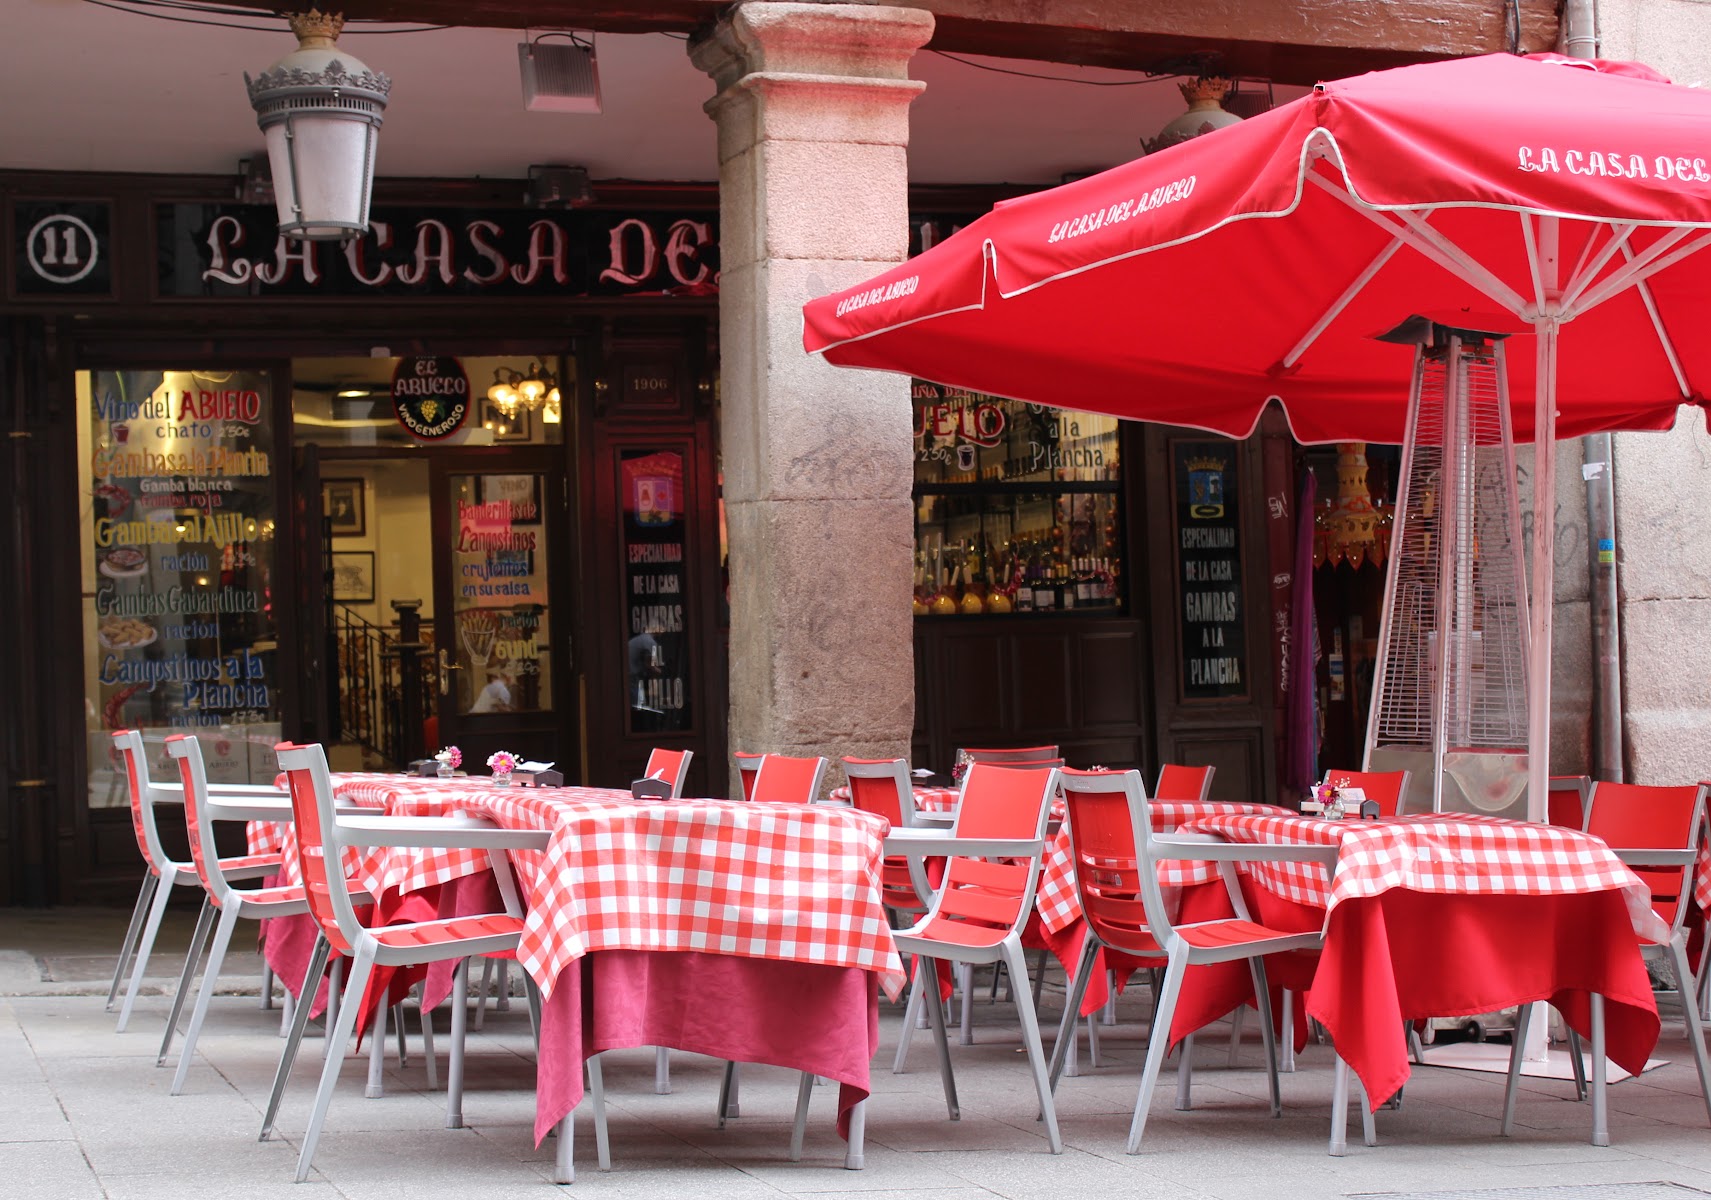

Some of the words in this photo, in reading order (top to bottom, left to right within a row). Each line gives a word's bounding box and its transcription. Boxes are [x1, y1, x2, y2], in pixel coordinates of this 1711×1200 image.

[1518, 146, 1560, 173] LA
[1565, 150, 1648, 179] CASA
[1654, 156, 1711, 182] DEL
[1048, 221, 1069, 243] LA
[1067, 208, 1105, 238] CASA
[1103, 199, 1134, 226] DEL
[1132, 175, 1197, 217] ABUELO
[42, 226, 79, 265] 11
[202, 215, 319, 285] LA
[344, 217, 568, 285] CASA
[598, 218, 720, 286] DE
[415, 360, 438, 375] EL
[394, 377, 466, 396] ABUELO
[633, 377, 669, 391] 1906
[95, 392, 140, 420] Vino
[144, 391, 170, 420] del
[177, 389, 261, 425] ABUELO
[398, 403, 416, 429] VINO
[414, 403, 465, 436] GENEROSO
[156, 422, 212, 438] chato
[92, 446, 177, 478] Gambas
[178, 454, 190, 474] a
[190, 447, 206, 475] la
[207, 446, 270, 477] Plancha
[1028, 440, 1105, 472] Plancha
[139, 478, 185, 492] Gamba
[187, 477, 233, 492] blanca
[189, 491, 223, 516] roja
[457, 498, 520, 520] Banderillas
[521, 500, 536, 520] de
[95, 514, 180, 548] Gambas
[182, 514, 200, 544] al
[203, 512, 258, 549] Ajillo
[456, 525, 537, 558] Langostinos
[1182, 527, 1235, 549] ESPECIALIDAD
[161, 552, 209, 572] ración
[628, 543, 682, 563] ESPECIALIDAD
[1186, 561, 1197, 581] DE
[1199, 560, 1209, 581] LA
[1210, 560, 1232, 581] CASA
[462, 583, 477, 597] en
[479, 583, 493, 596] su
[494, 580, 531, 596] salsa
[632, 575, 645, 595] DE
[645, 574, 657, 595] LA
[657, 574, 680, 594] CASA
[95, 584, 165, 616] Gambas
[168, 585, 259, 614] Gabardina
[1186, 591, 1236, 623] GAMBAS
[164, 620, 219, 640] ración
[631, 604, 683, 634] GAMBAS
[1202, 627, 1210, 648] A
[1211, 627, 1225, 648] LA
[650, 645, 665, 667] AL
[99, 654, 221, 693] Langostinos
[226, 660, 240, 679] a
[243, 647, 264, 680] la
[1190, 657, 1241, 686] PLANCHA
[183, 680, 270, 710] Plancha
[170, 710, 221, 728] ración
